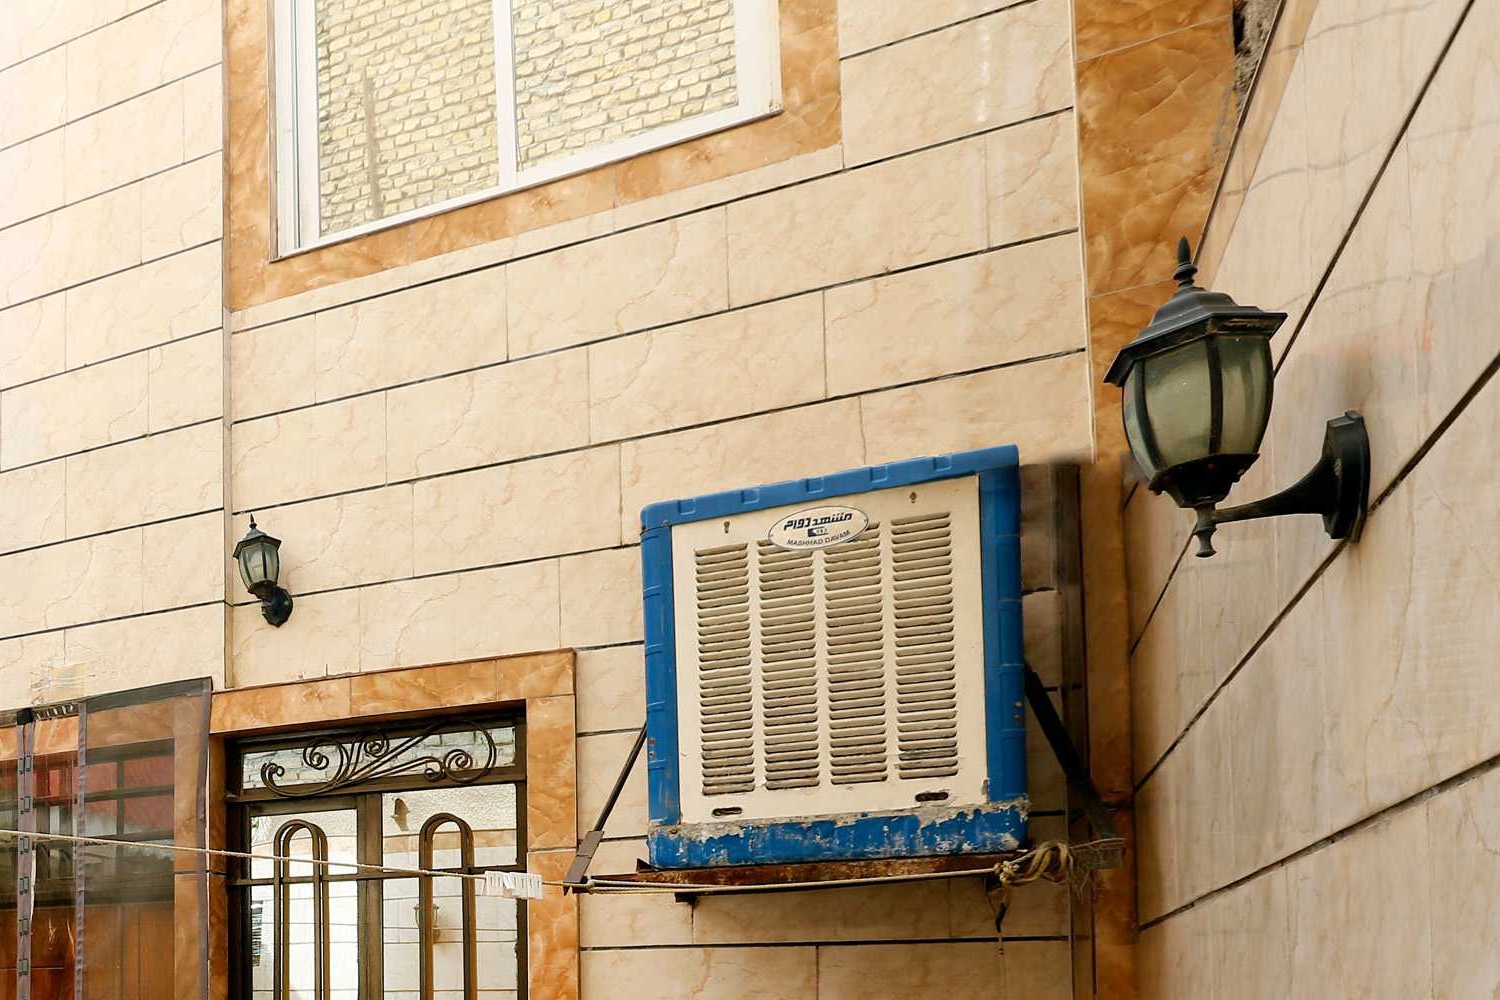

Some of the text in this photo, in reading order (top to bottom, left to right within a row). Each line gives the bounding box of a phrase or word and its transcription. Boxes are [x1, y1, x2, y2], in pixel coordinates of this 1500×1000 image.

[783, 512, 852, 531] مشهد دوام
[787, 538, 824, 546] MASHHAD
[825, 530, 851, 543] DAVAM
